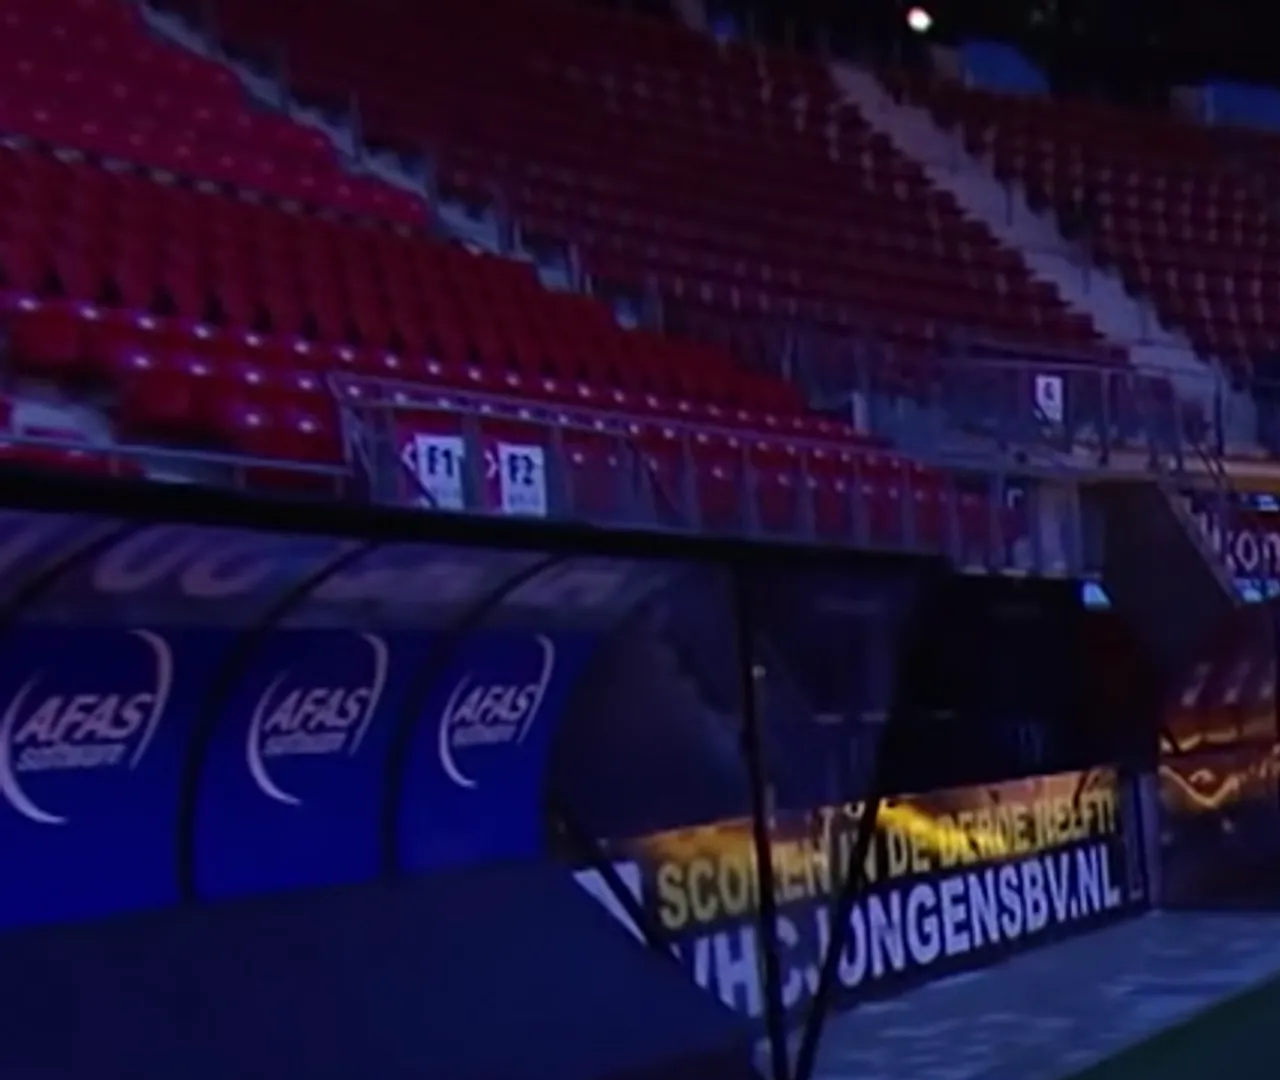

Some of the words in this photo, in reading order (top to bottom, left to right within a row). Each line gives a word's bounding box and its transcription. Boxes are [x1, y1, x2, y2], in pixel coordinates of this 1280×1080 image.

[428, 445, 453, 477] F1
[508, 453, 534, 486] F2
[15, 692, 158, 743] AFAS
[264, 686, 372, 732] AFAS
[453, 684, 542, 723] AFAS
[887, 826, 930, 878] DE
